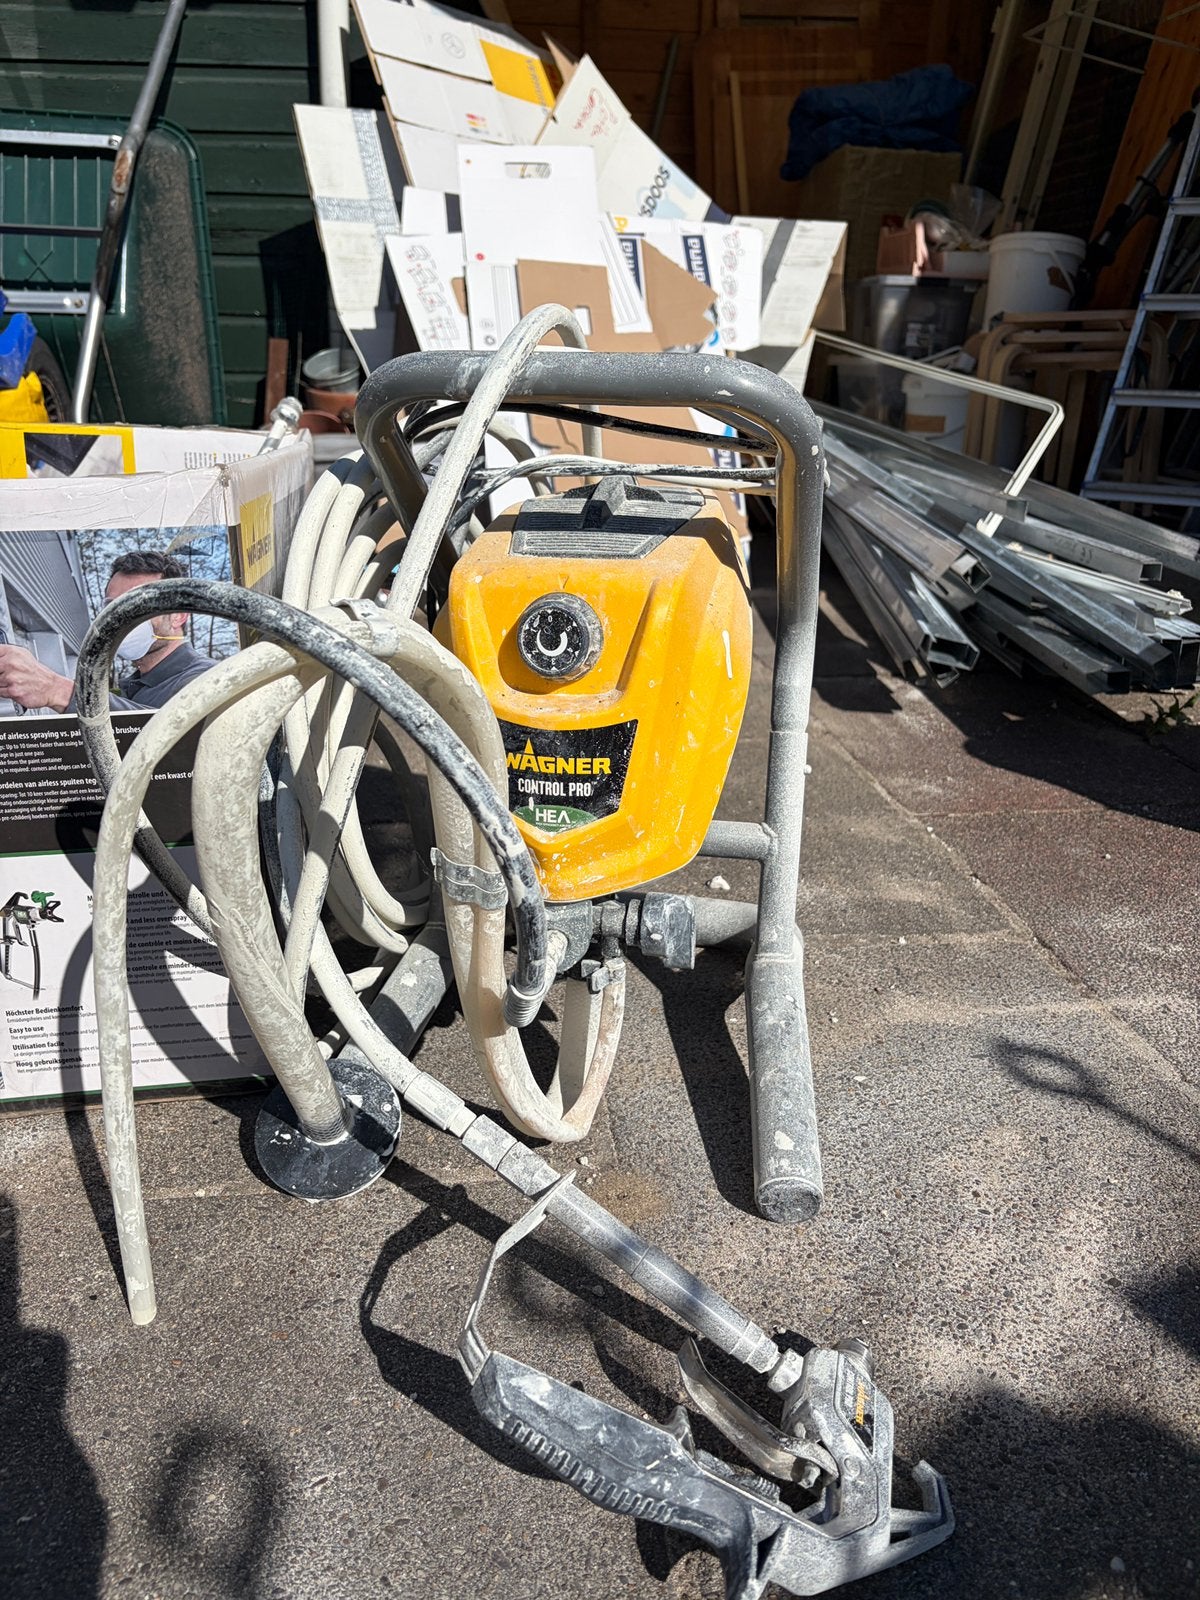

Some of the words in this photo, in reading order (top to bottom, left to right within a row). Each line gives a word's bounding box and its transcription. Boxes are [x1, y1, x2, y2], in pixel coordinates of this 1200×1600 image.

[7, 731, 29, 740] airless
[30, 730, 59, 740] spraying
[506, 738, 612, 775] WAGNER
[24, 780, 37, 788] van
[38, 779, 59, 788] airless
[60, 778, 84, 787] spuiten
[517, 778, 567, 797] CONTROL
[568, 782, 592, 797] PRO
[5, 1008, 34, 1017] Höchster
[35, 1005, 84, 1014] Bedienkomfort
[9, 1026, 24, 1034] Easy
[12, 1043, 46, 1051] Utilisation
[16, 1060, 33, 1068] Hoog
[34, 1056, 82, 1065] gebruiksgemak
